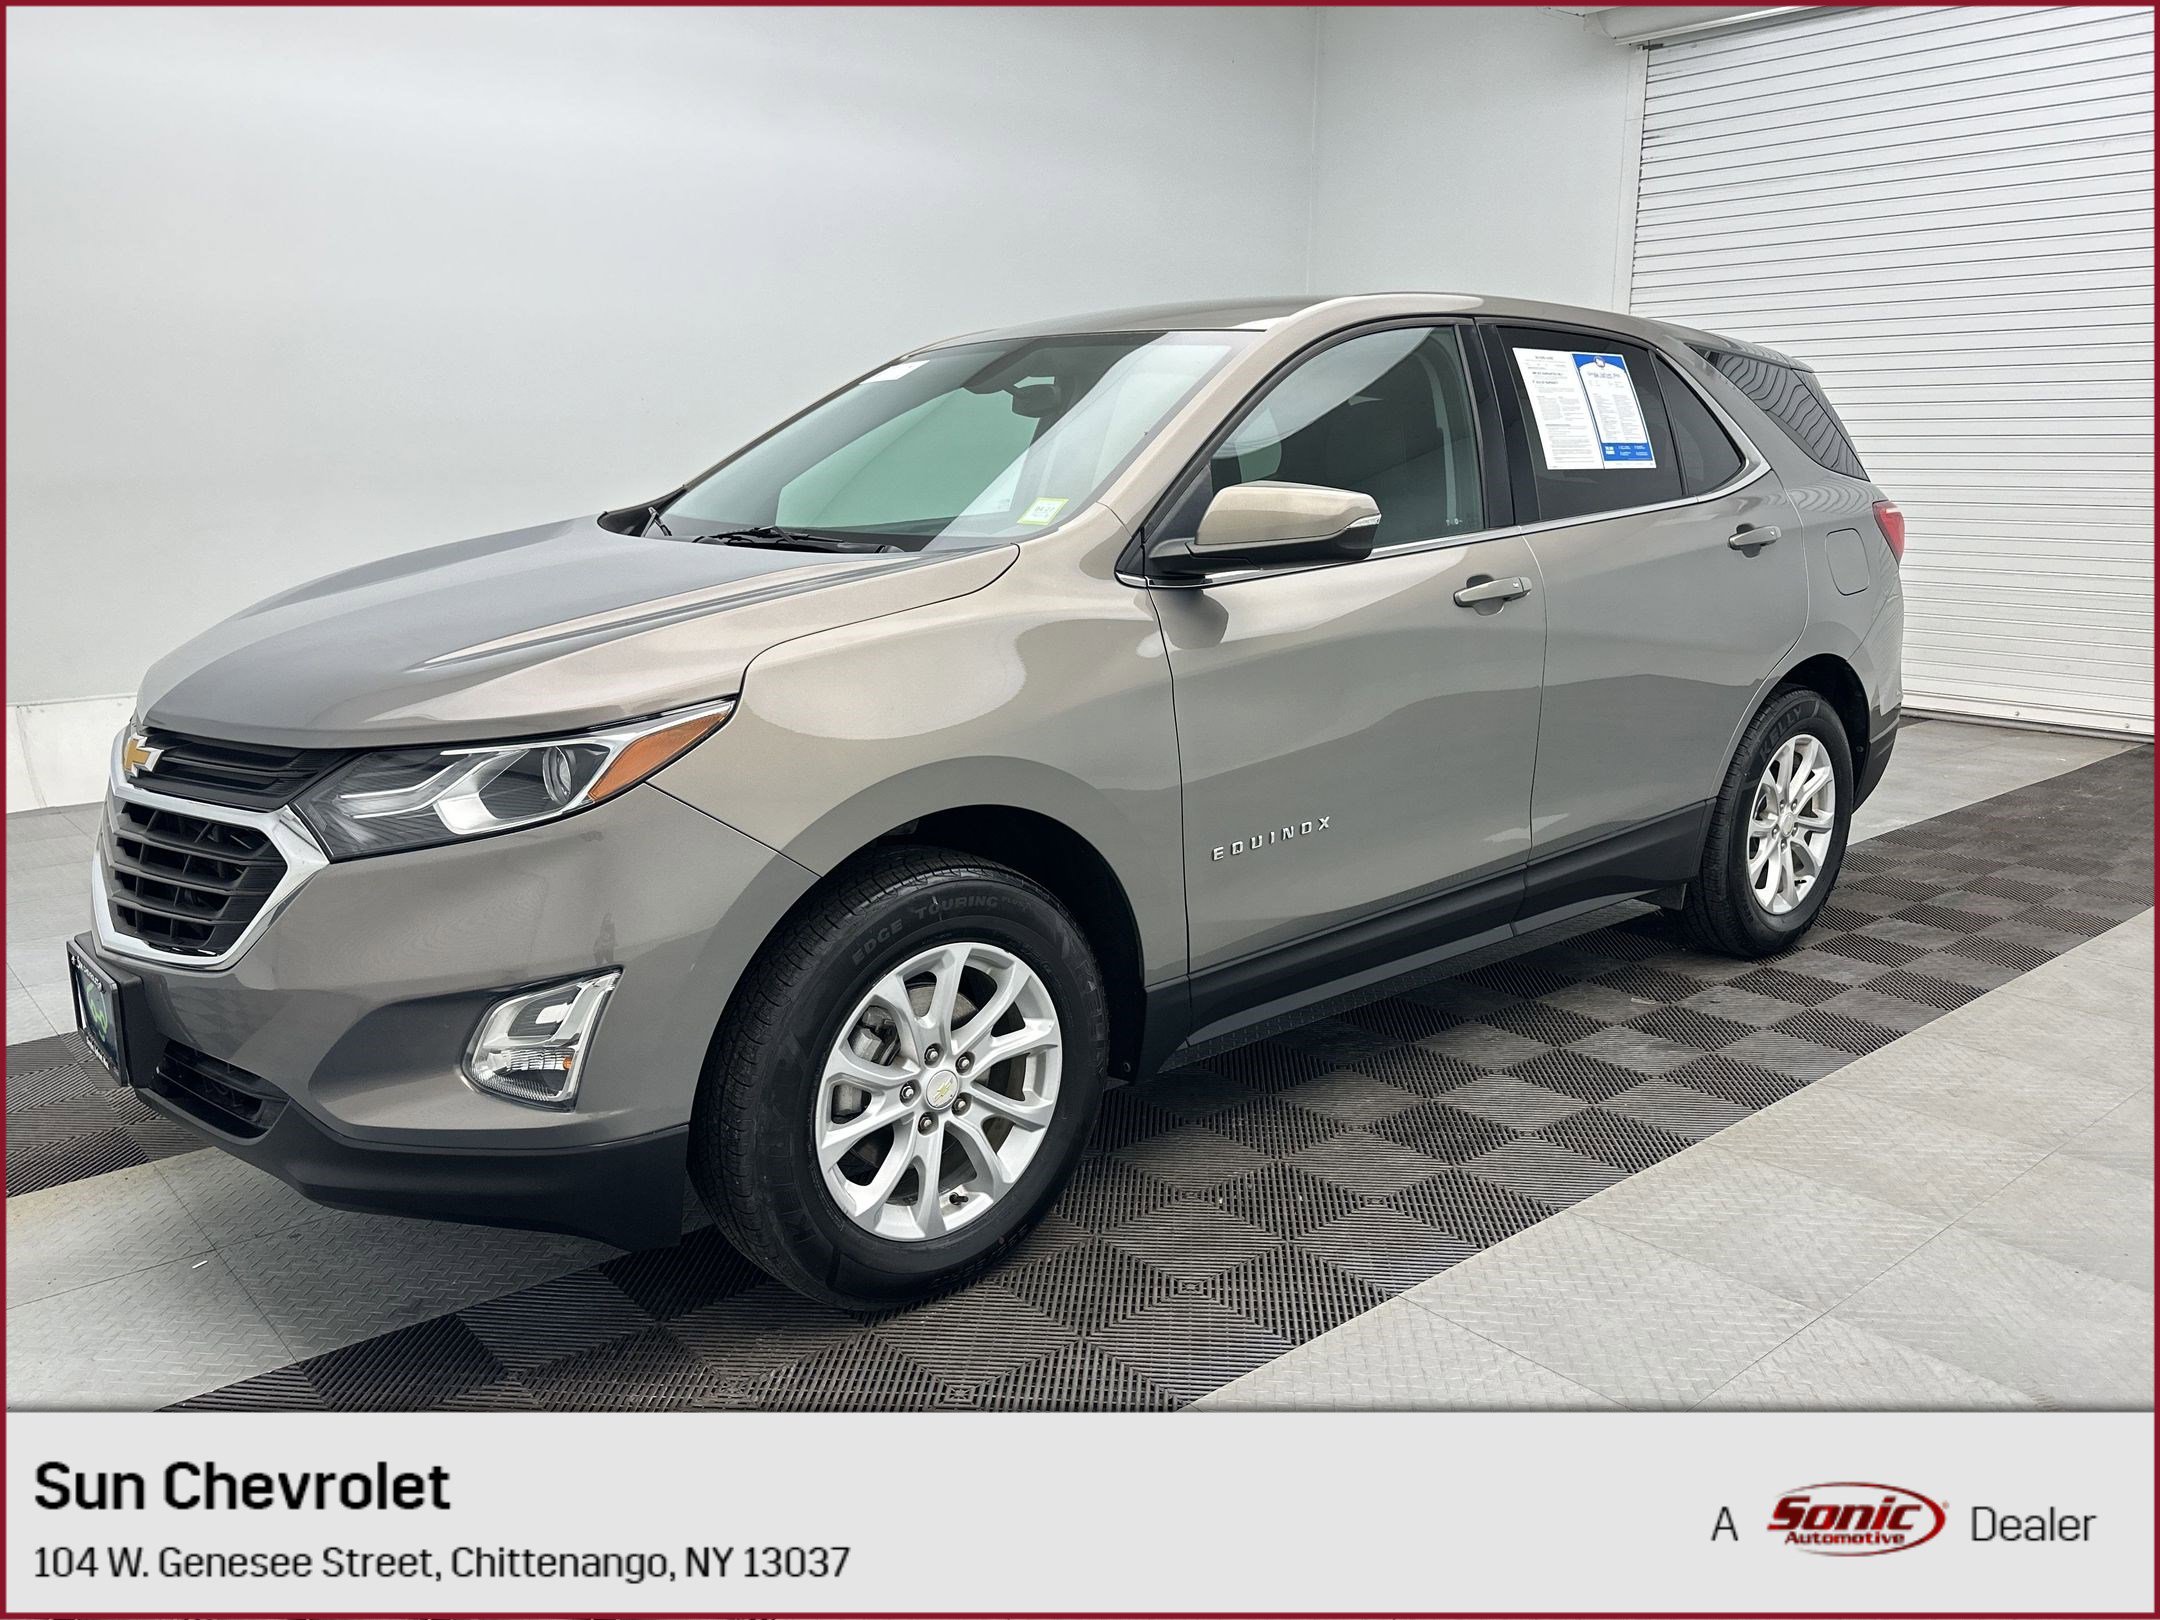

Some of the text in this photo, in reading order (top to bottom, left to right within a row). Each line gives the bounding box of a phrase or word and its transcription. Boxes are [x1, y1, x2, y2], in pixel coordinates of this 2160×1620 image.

[1211, 815, 1331, 862] EQUINOX
[851, 917, 904, 967] EDGE
[914, 894, 999, 921] TOURING
